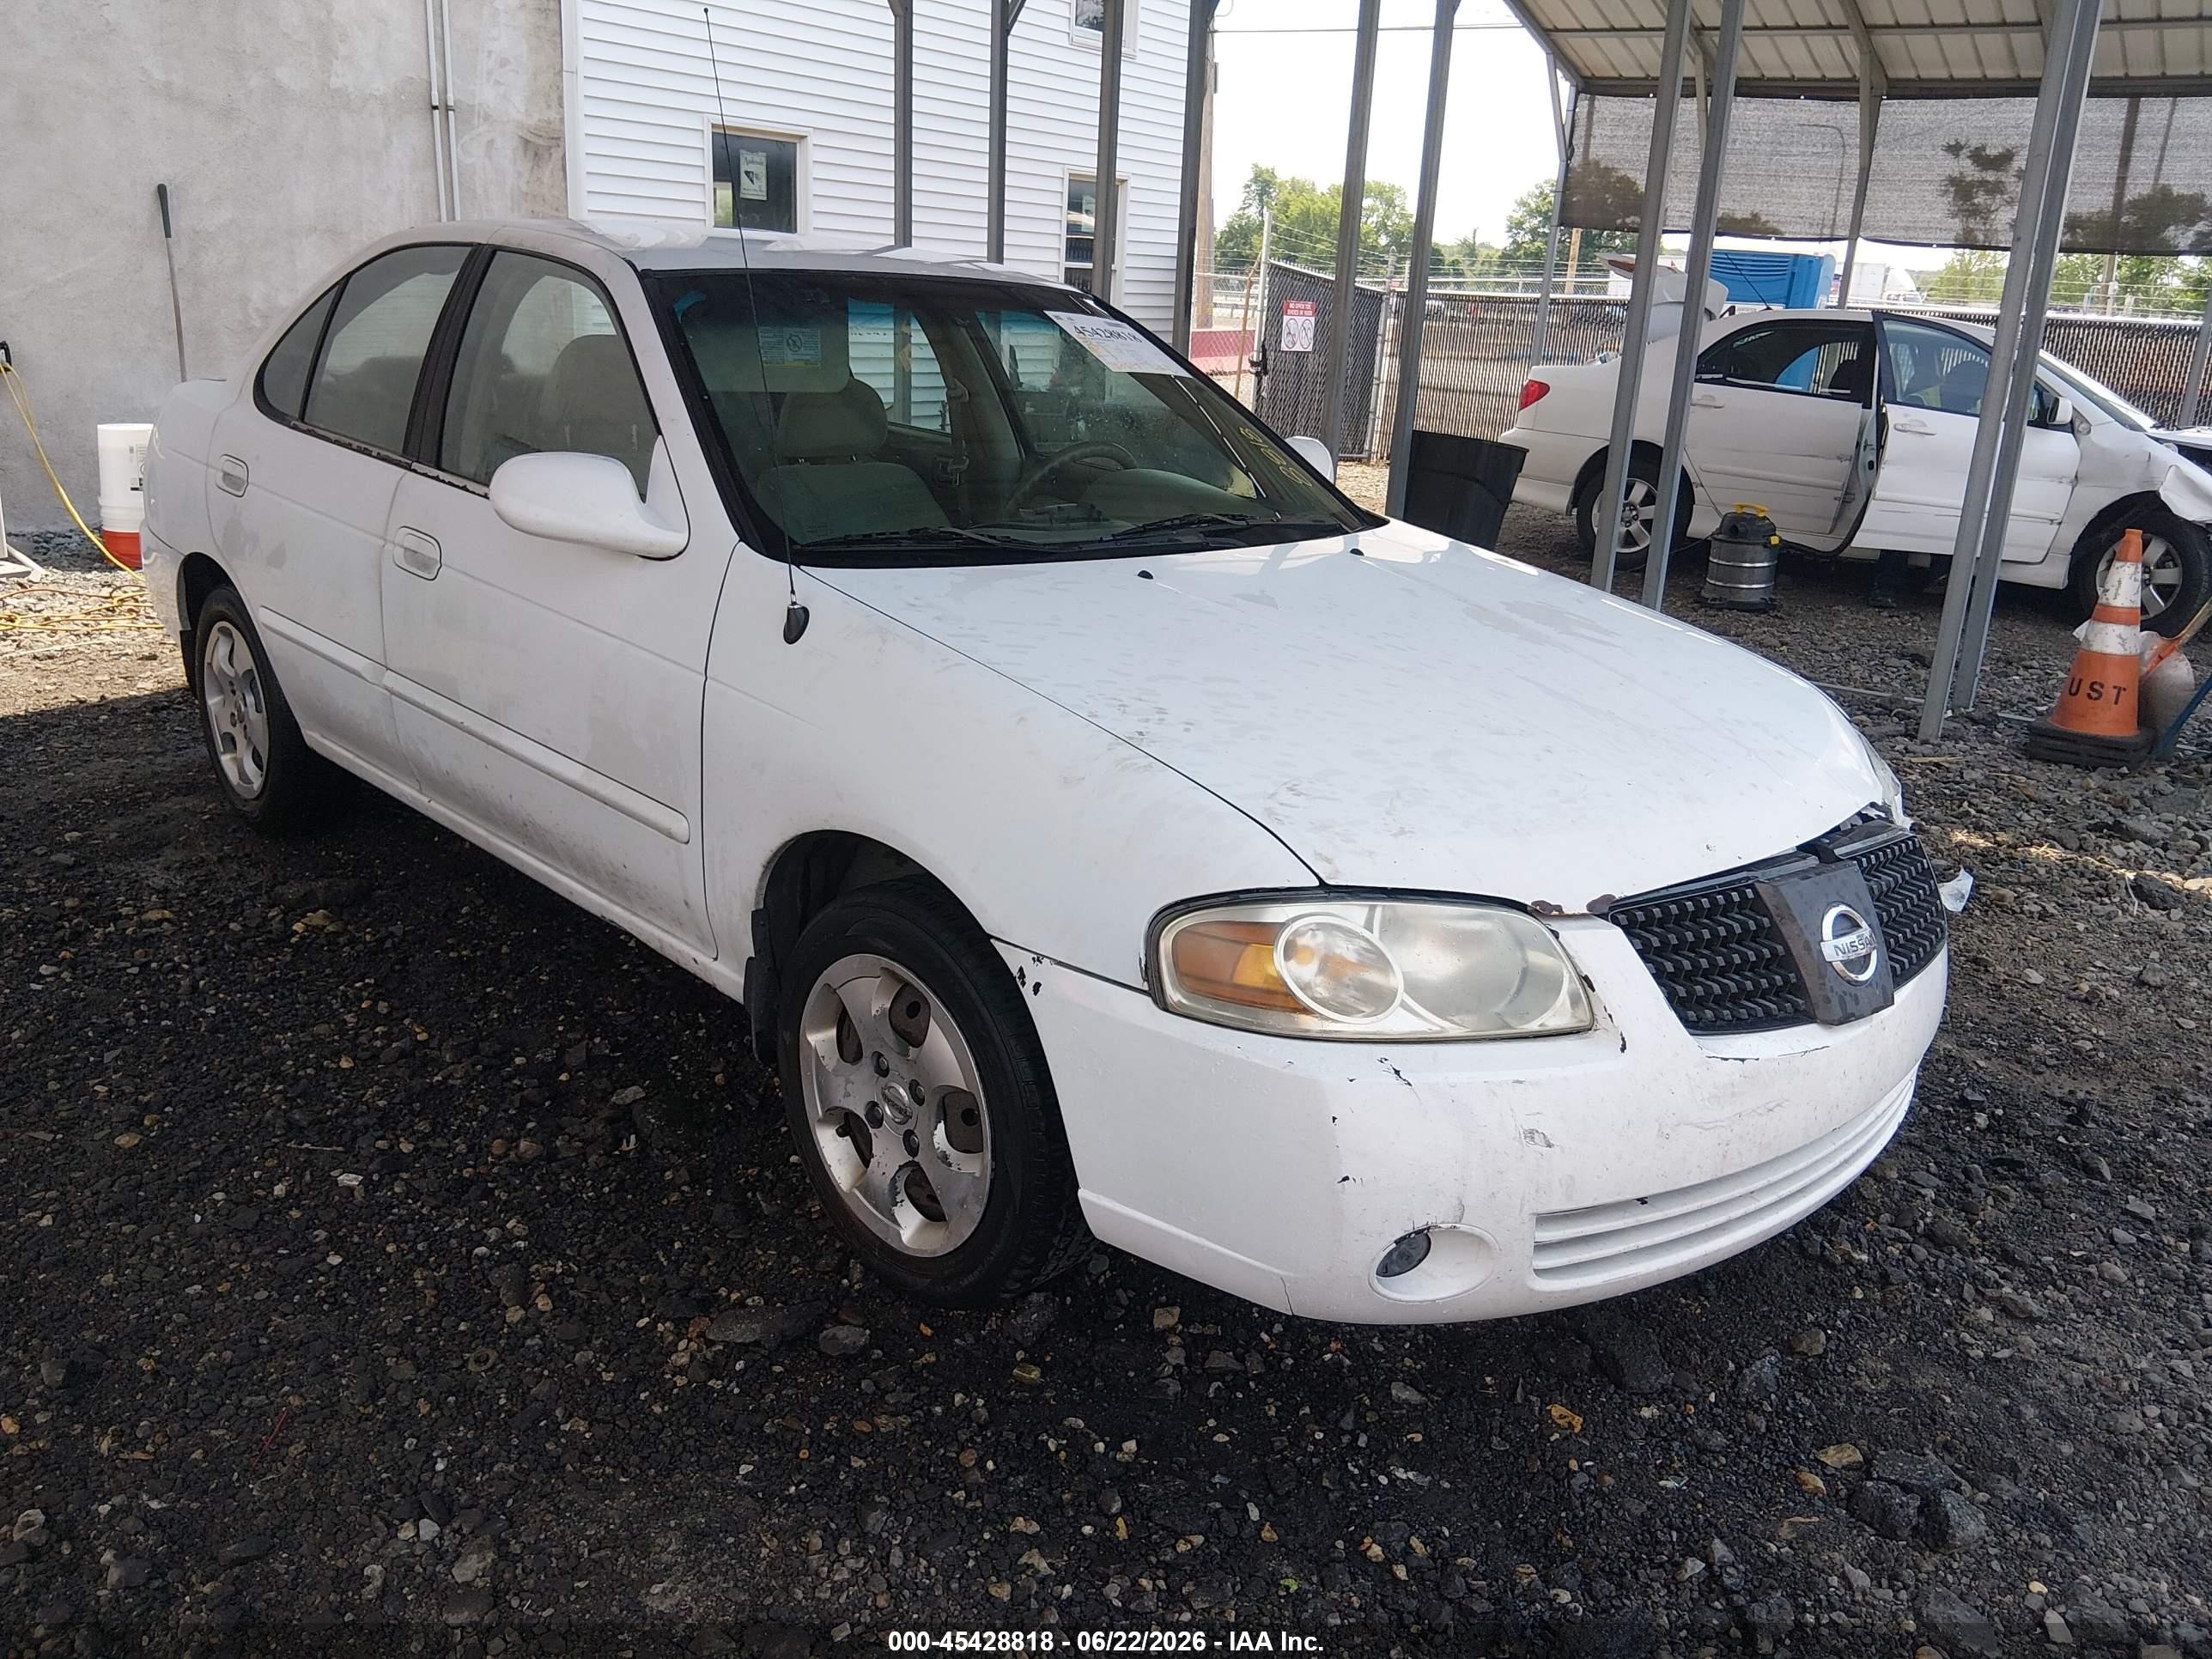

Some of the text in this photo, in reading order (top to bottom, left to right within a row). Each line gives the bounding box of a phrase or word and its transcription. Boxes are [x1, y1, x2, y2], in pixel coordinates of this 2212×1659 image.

[1073, 325, 1143, 343] 45428818
[2068, 678, 2127, 706] UST
[1833, 933, 1876, 957] NISSAN
